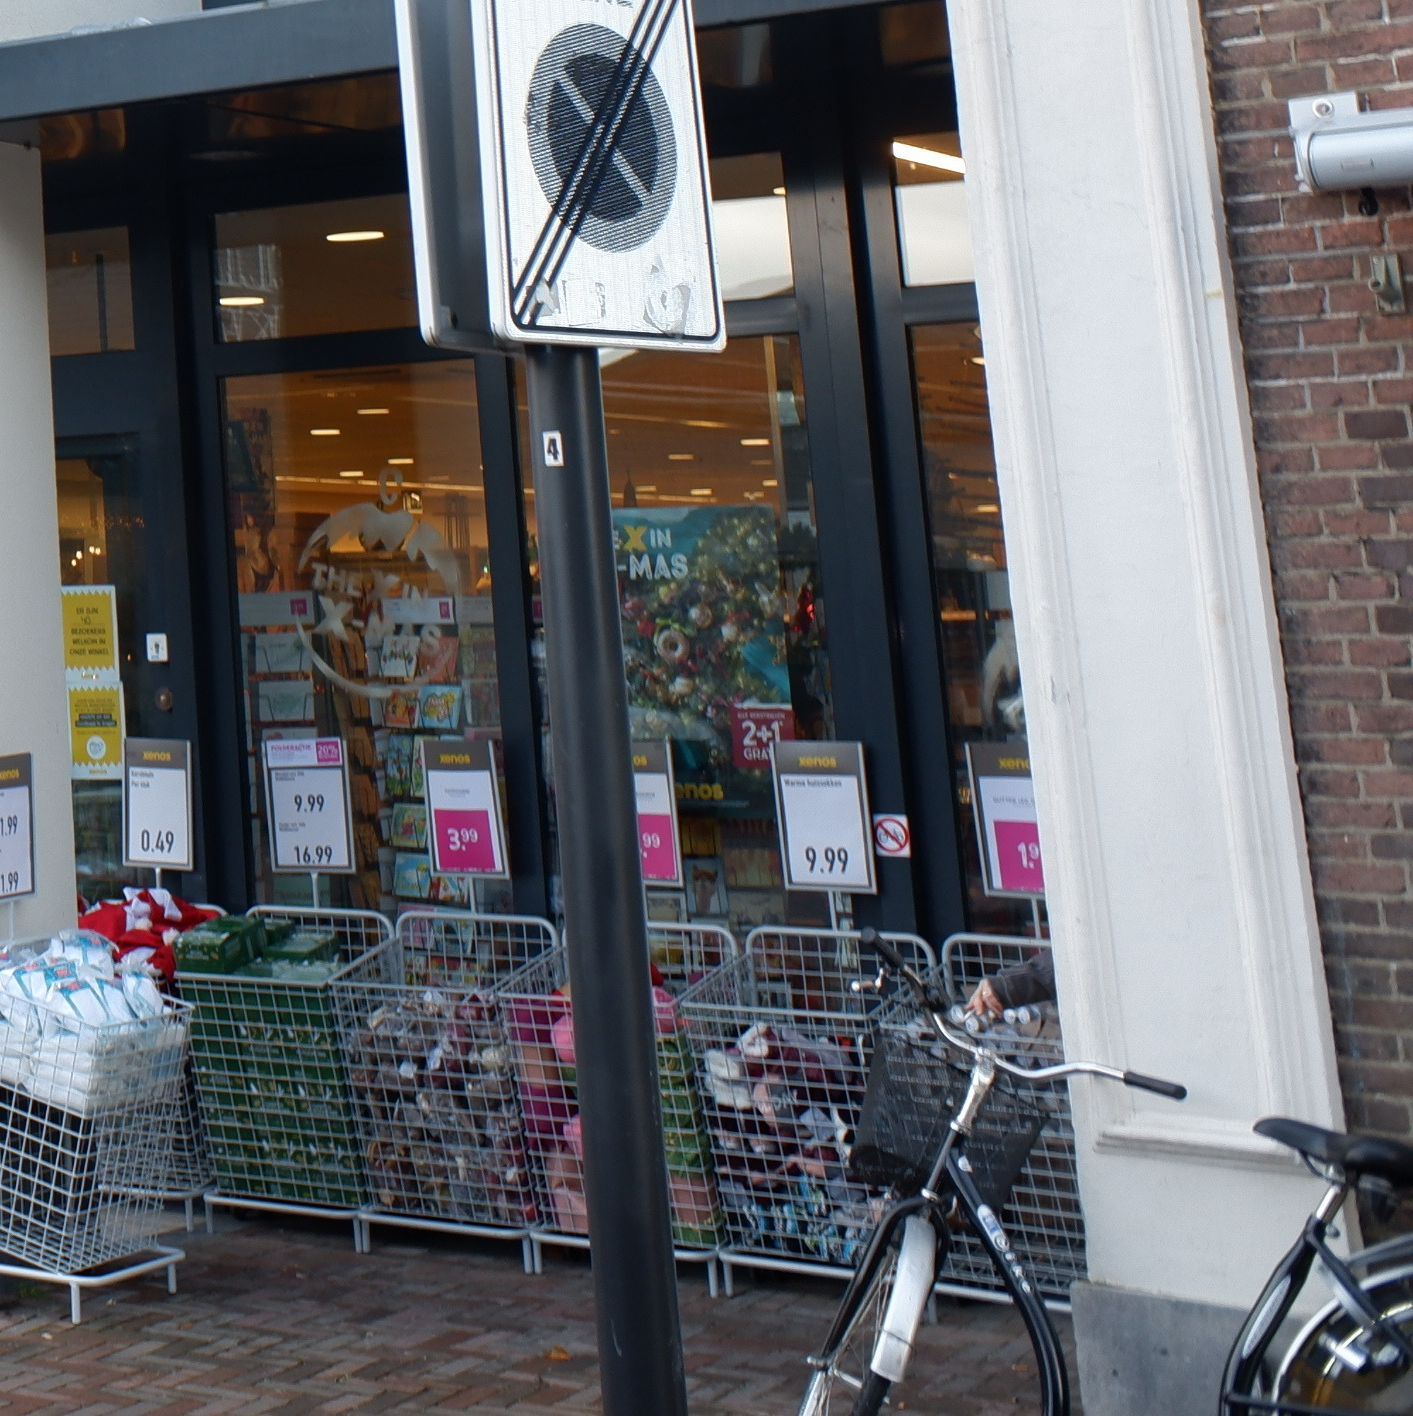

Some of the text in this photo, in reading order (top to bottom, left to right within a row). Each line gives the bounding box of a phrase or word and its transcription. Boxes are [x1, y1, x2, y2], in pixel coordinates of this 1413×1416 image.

[547, 438, 560, 461] 4
[623, 524, 648, 552] X
[650, 527, 672, 549] IN
[617, 552, 689, 580] -MAS
[142, 750, 171, 761] xenos
[439, 753, 470, 764] xenos
[743, 747, 770, 761] GRA
[798, 756, 837, 768] xenos
[999, 757, 1030, 770] xen
[294, 794, 325, 813] 9.99
[675, 782, 725, 803] enos
[0, 814, 18, 837] 1.99
[141, 829, 174, 854] 0.49
[447, 827, 478, 852] 3.99
[640, 832, 661, 859] .99
[294, 845, 332, 865] 16.99
[805, 846, 849, 874] 9.99
[1017, 841, 1039, 870] 1.9
[0, 870, 19, 894] 1.99
